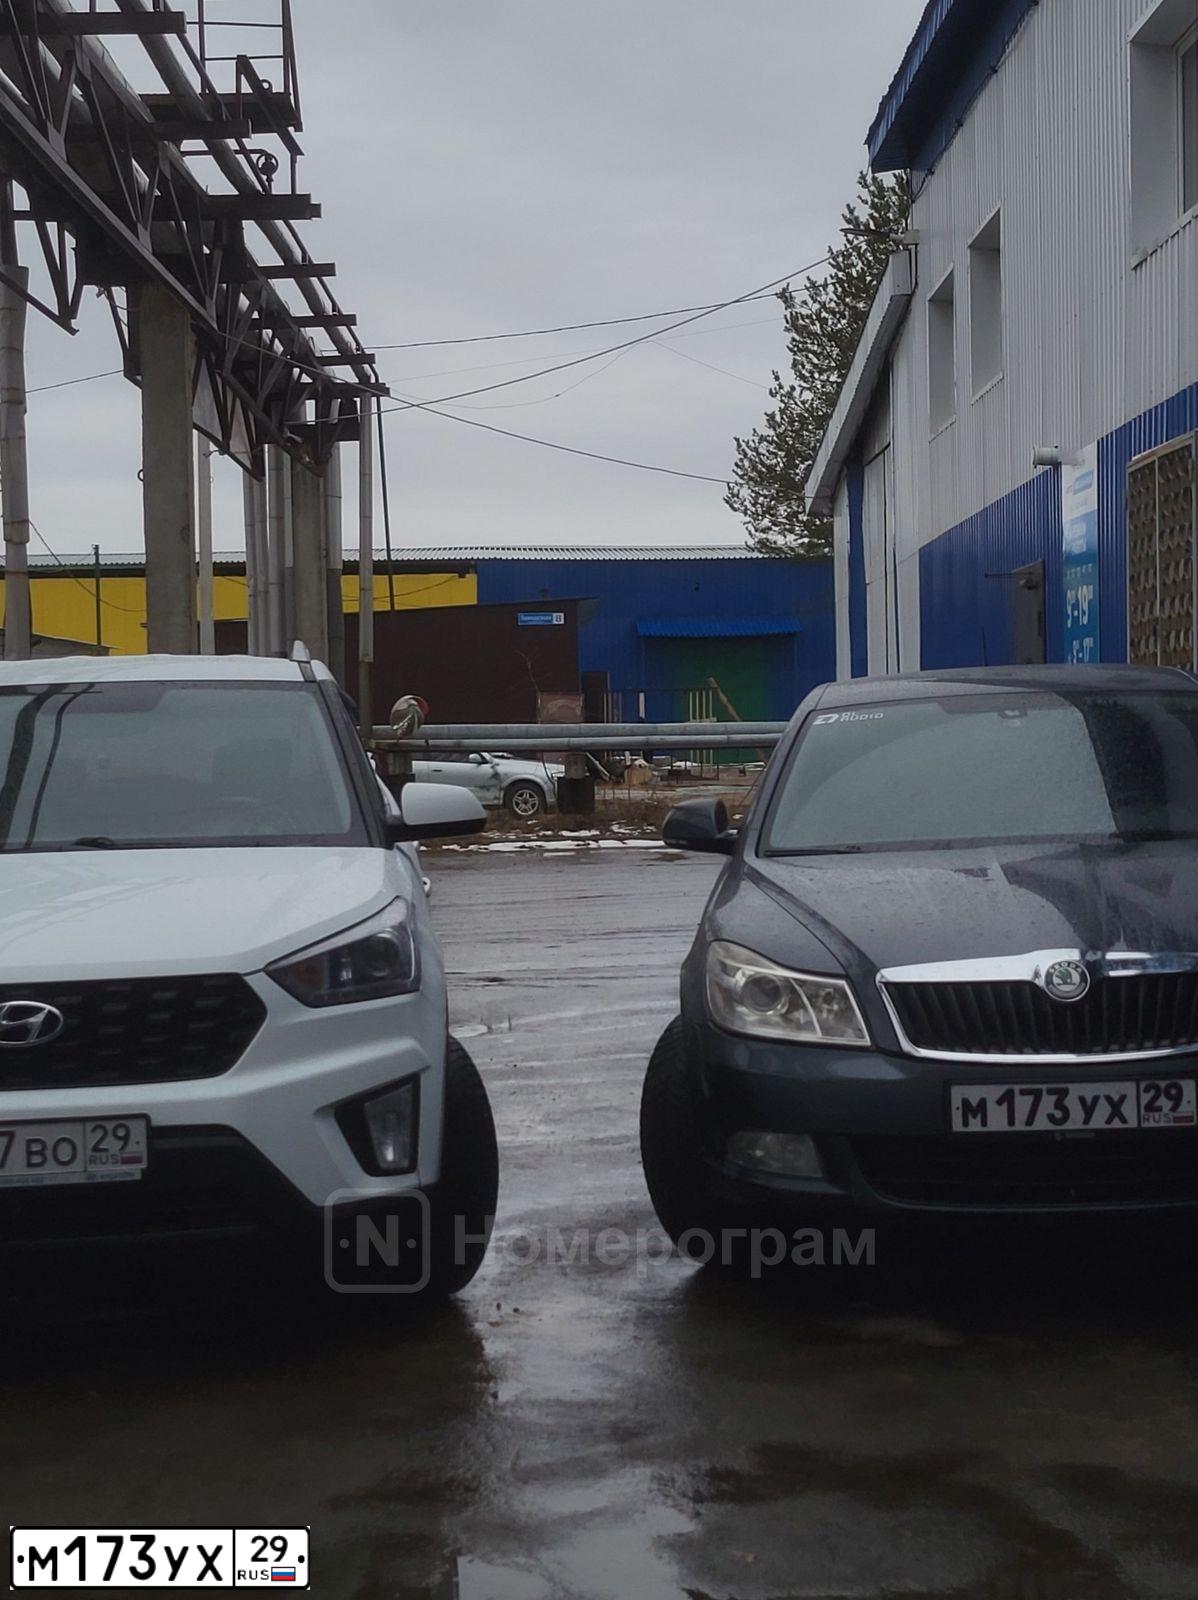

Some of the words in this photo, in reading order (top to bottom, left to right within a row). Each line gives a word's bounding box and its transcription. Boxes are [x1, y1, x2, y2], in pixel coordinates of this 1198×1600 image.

[961, 1086, 1128, 1128] М173УХ
[1143, 1081, 1183, 1113] 29
[1142, 1112, 1172, 1125] RUS
[90, 1122, 131, 1153] 29
[88, 1151, 120, 1166] RUS
